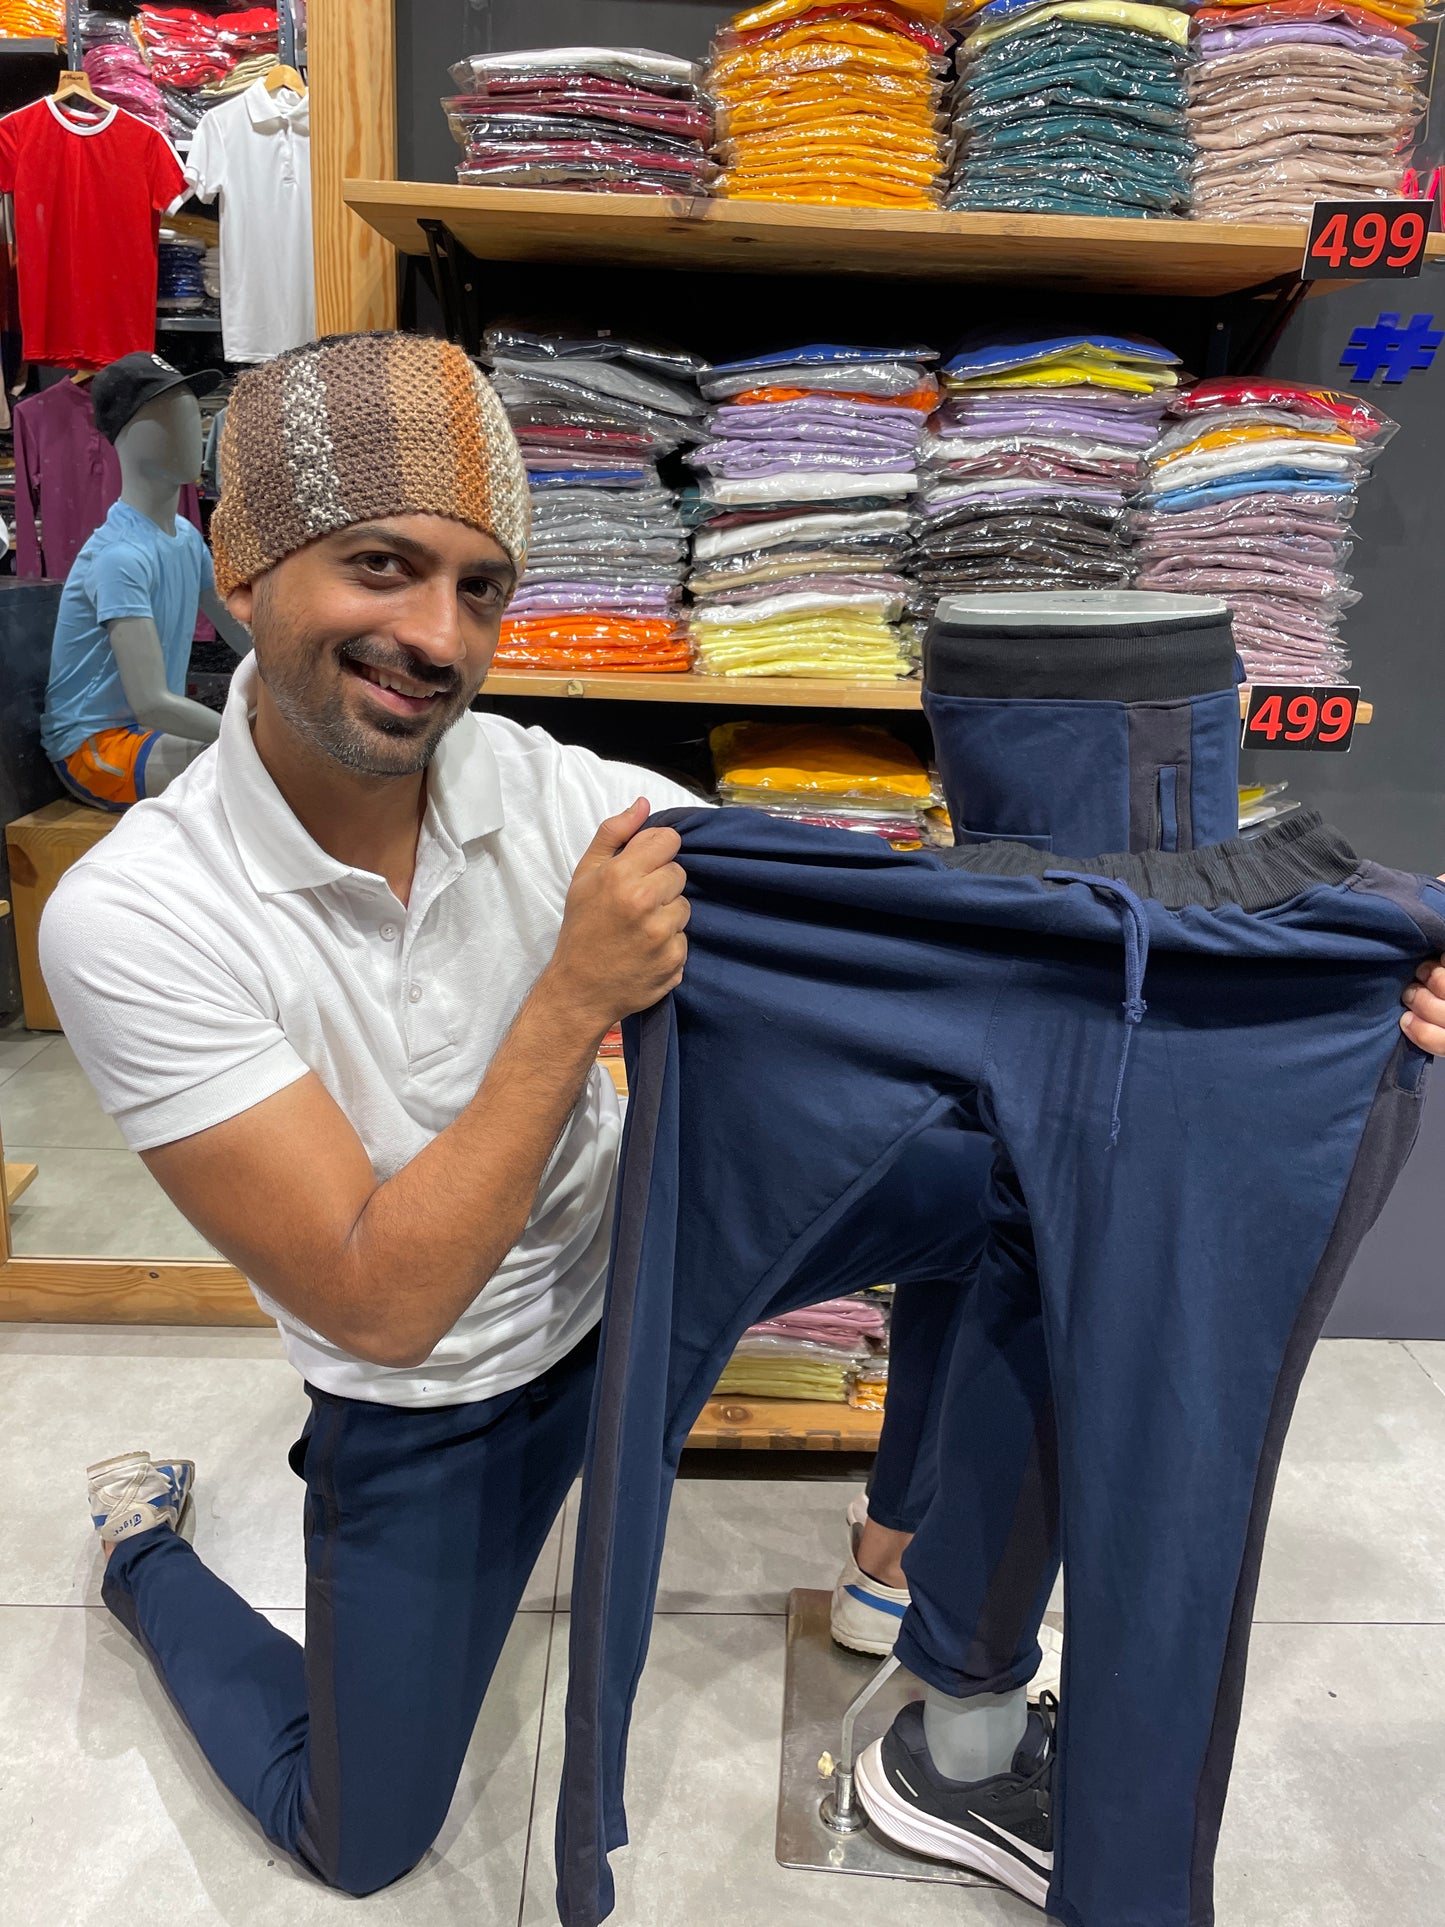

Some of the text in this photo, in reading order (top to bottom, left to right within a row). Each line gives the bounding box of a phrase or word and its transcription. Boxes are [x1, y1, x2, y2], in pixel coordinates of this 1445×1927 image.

[1311, 212, 1425, 268] 499
[1249, 695, 1353, 743] 499
[112, 1513, 142, 1537] Tiger
